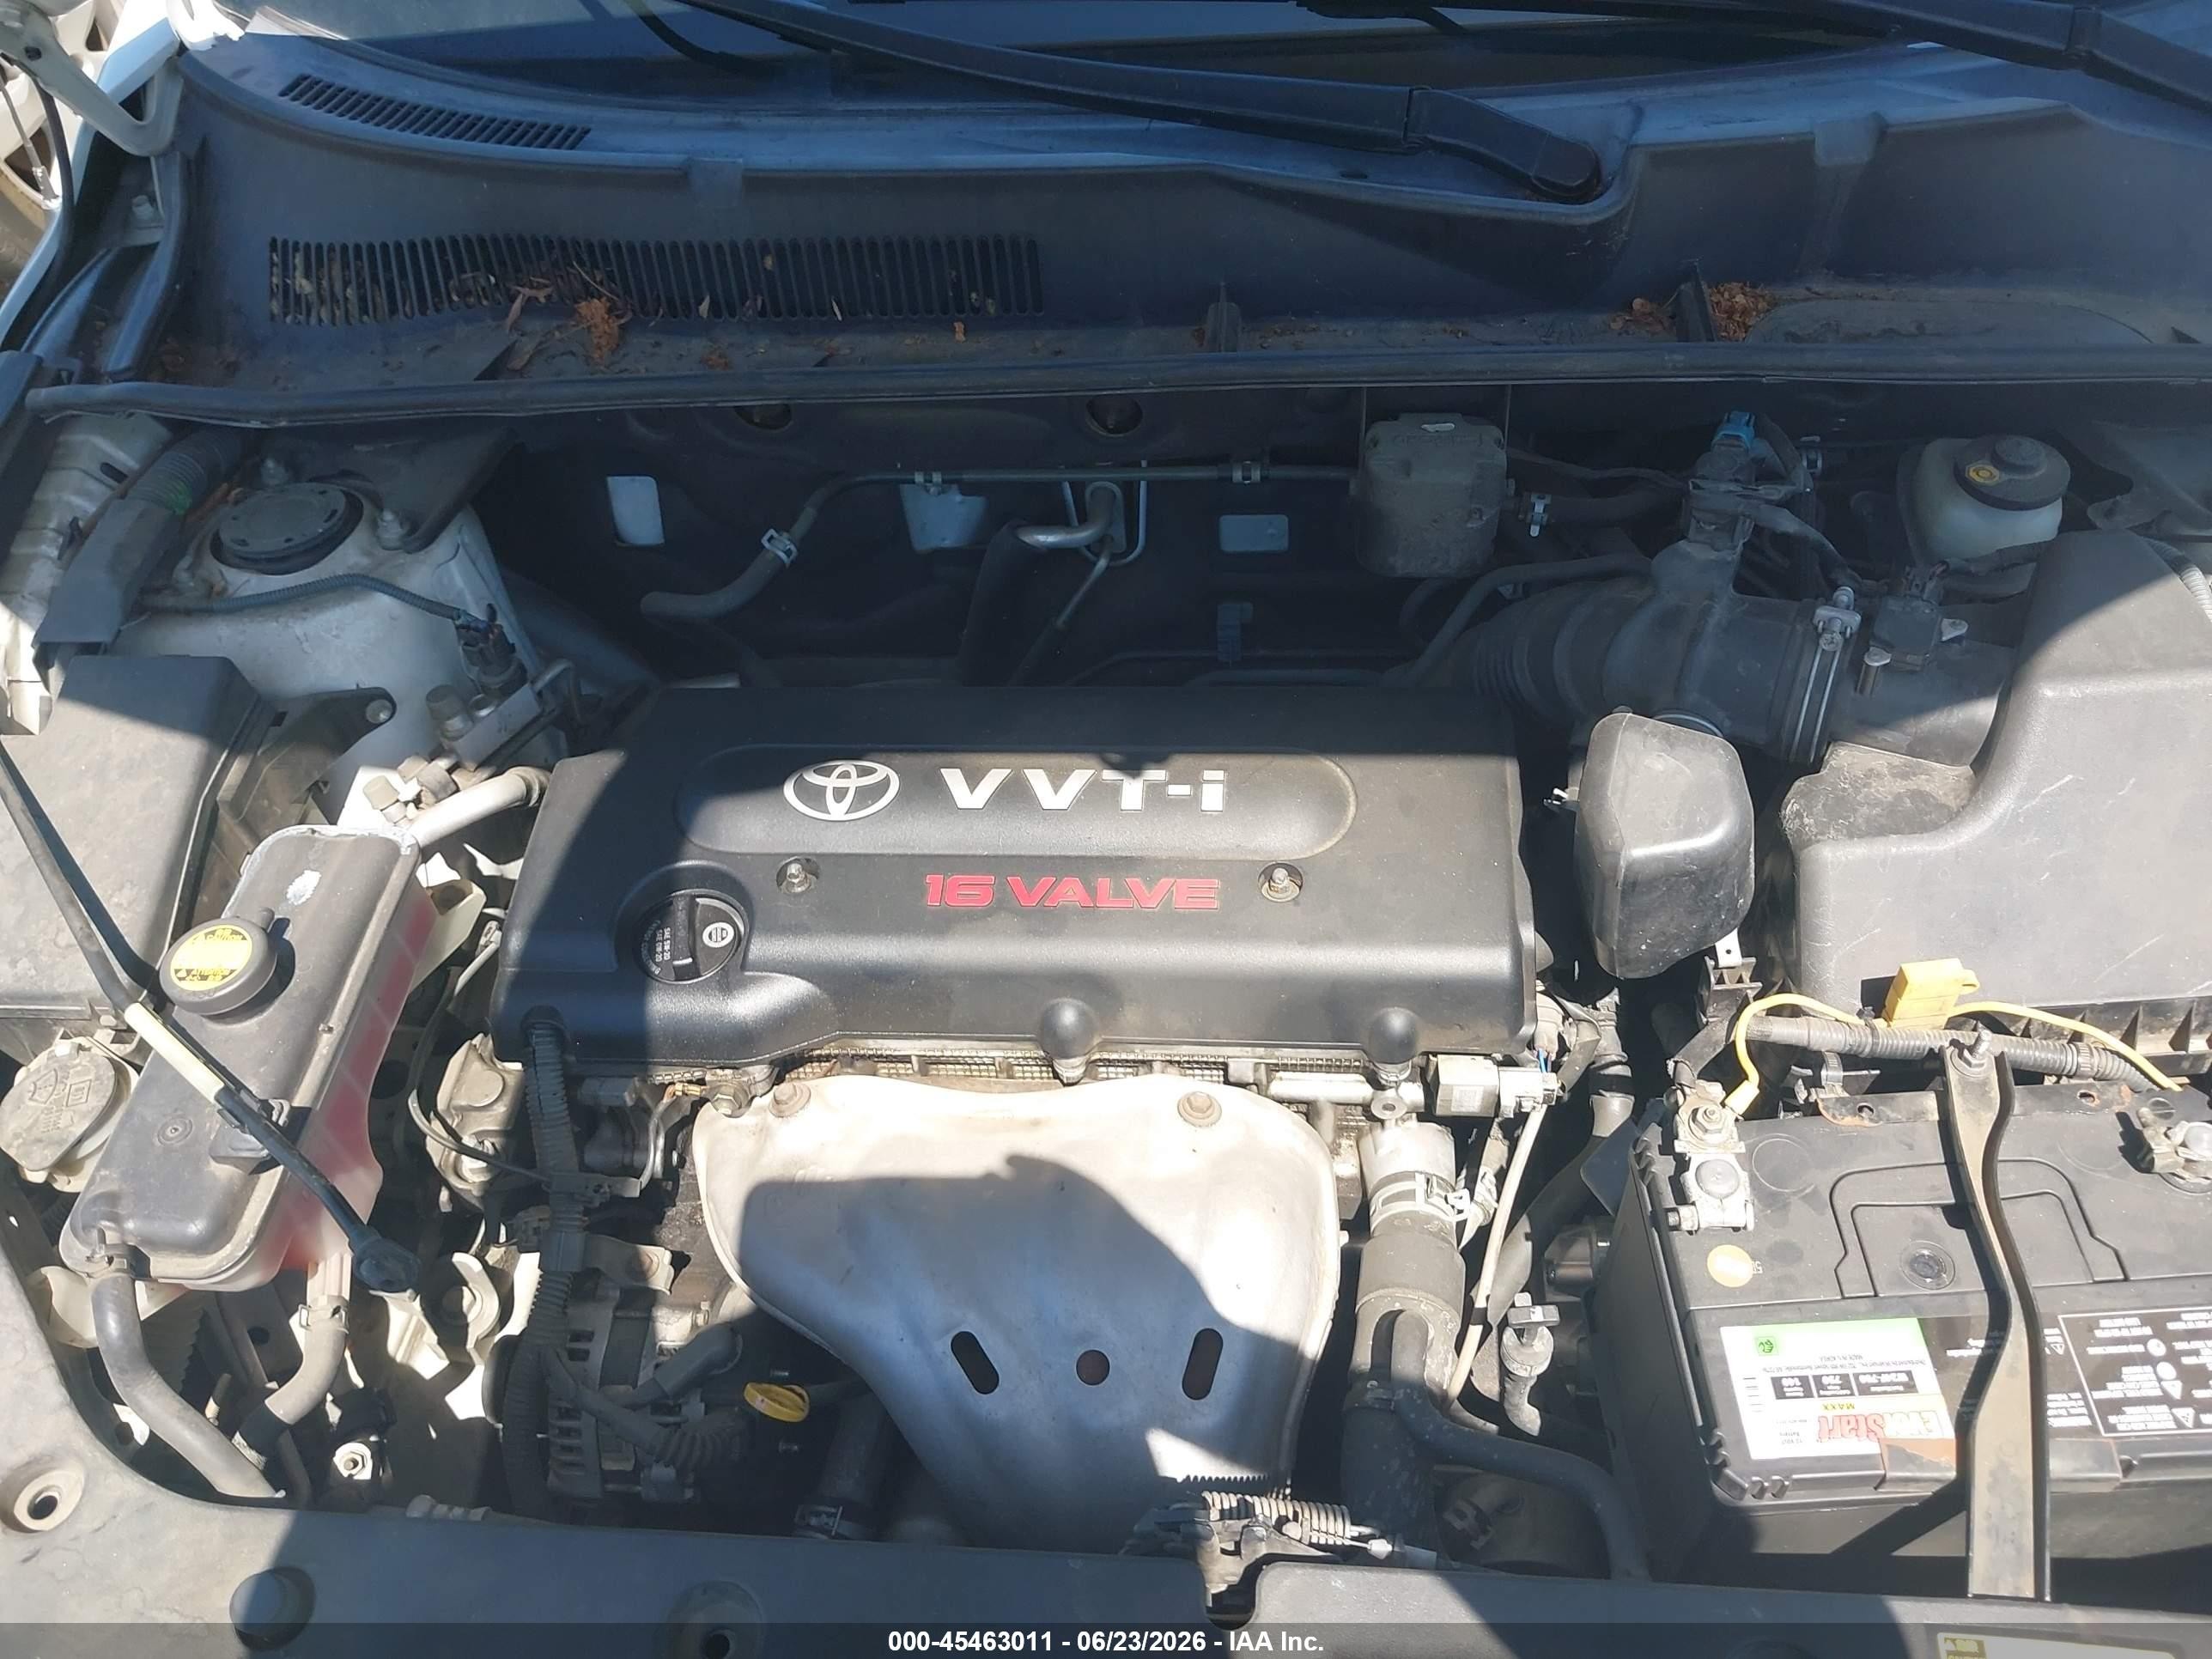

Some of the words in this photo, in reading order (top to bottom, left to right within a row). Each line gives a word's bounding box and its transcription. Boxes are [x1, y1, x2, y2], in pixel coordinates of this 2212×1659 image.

[939, 768, 1228, 812] VVT-i
[925, 874, 996, 910] 16
[1002, 876, 1221, 912] VALVE
[1820, 1402, 1856, 1412] MAXX
